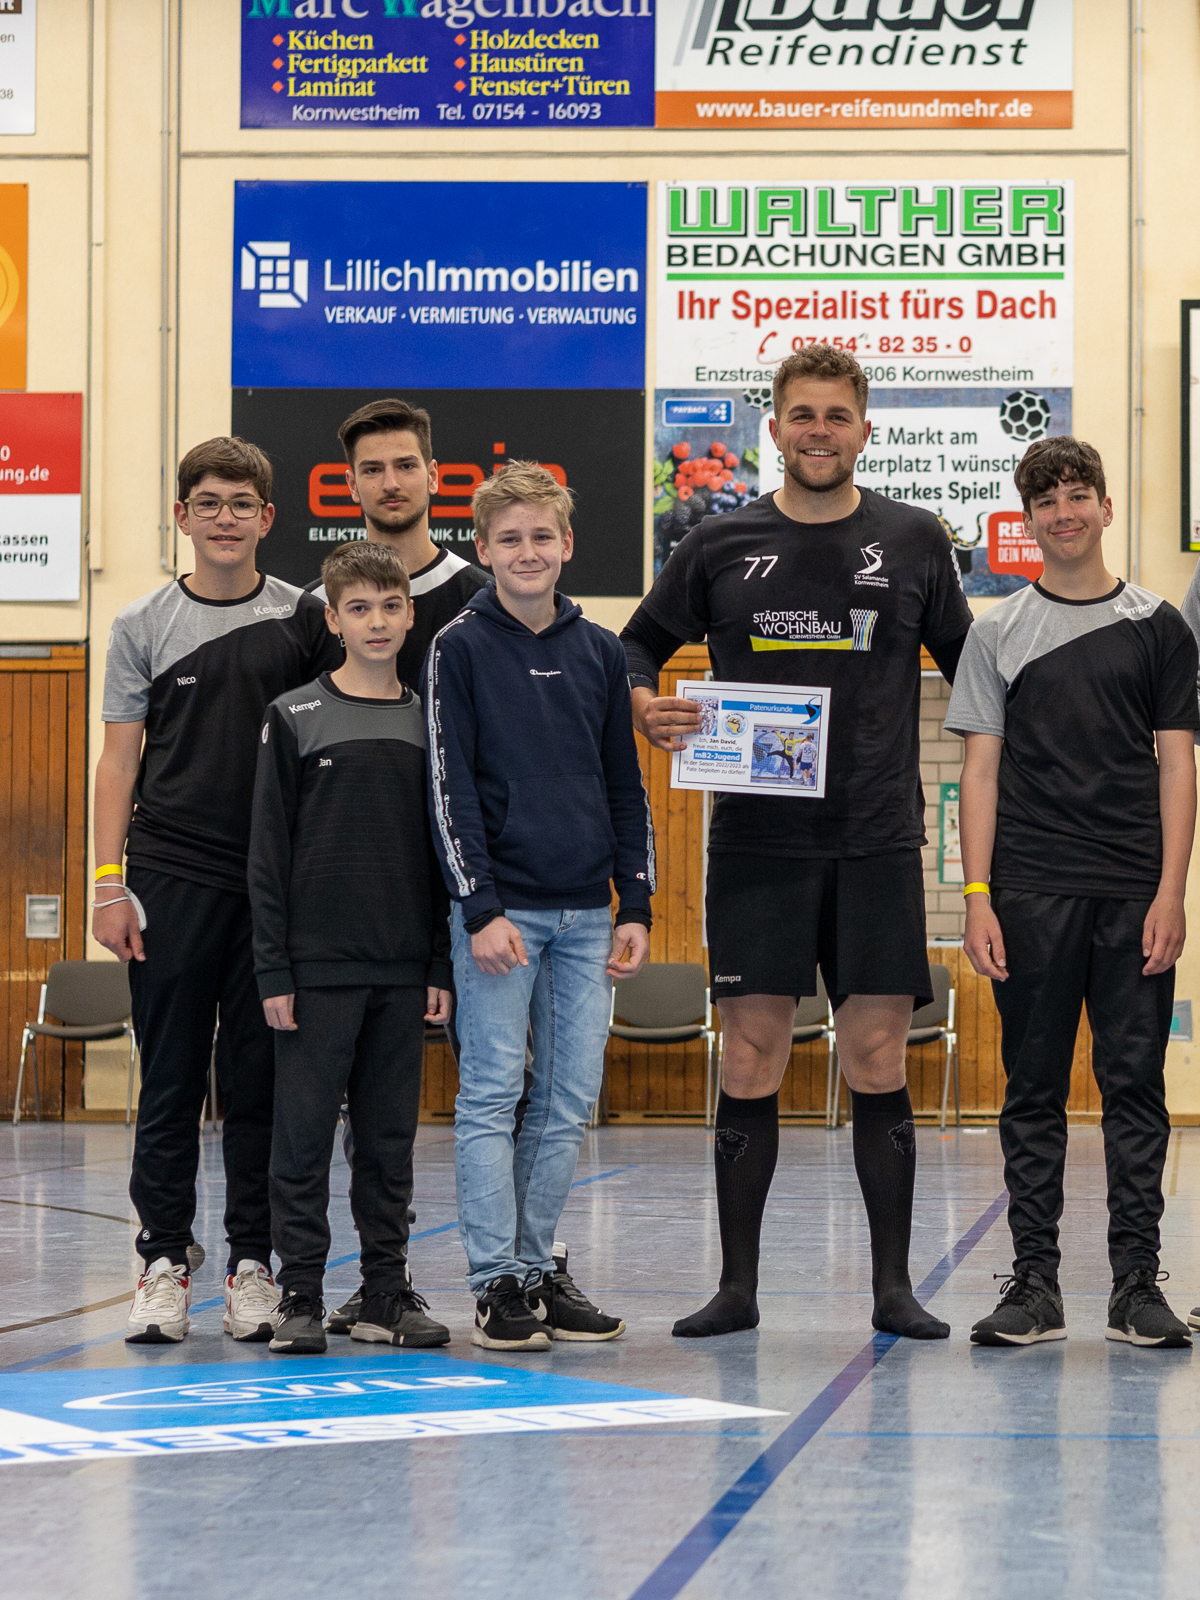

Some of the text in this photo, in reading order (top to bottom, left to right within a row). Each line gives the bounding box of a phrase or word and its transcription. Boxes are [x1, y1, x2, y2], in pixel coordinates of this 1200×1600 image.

[287, 30, 373, 50] Küchen
[469, 29, 599, 50] Holzdecken
[706, 35, 1028, 66] Reifendienst
[287, 53, 428, 78] Fertigparkett
[469, 53, 584, 73] Haustüren
[287, 77, 375, 97] Laminat
[469, 76, 630, 96] Fenster+Türen
[292, 103, 602, 121] Kornwestheim Tel. 07154 16093
[696, 98, 1033, 118] www.bauer-reifenundmehr.de
[667, 187, 1066, 237] WALTHER
[667, 243, 1066, 268] BEDACHUNGEN GMBH
[324, 259, 639, 292] LillichImmobilien
[325, 306, 637, 325] VERKAUF VERMIETUNG VERWALTUNG
[677, 288, 1057, 327] Ihr Spezialist fürs Dach
[879, 336, 905, 352] 82
[912, 336, 938, 352] 35
[959, 336, 972, 352] 0
[695, 366, 778, 382] Enzstras
[902, 366, 1034, 382] Kornwestheim
[887, 427, 943, 446] Markt
[949, 432, 978, 446] am
[939, 454, 946, 472] 1
[952, 454, 1020, 472] wünsch
[948, 481, 1001, 504] Spiel!
[0, 534, 48, 546] assen
[998, 547, 1043, 563] DEIN MAR
[743, 555, 779, 580] 77
[253, 602, 292, 617] Kempa
[753, 610, 819, 624] STÄDTISCHE
[759, 621, 842, 636] WOHNBAU
[177, 674, 197, 686] Nico
[288, 698, 322, 714] Kempa
[750, 703, 793, 713] Patenurkunde
[318, 757, 332, 767] Jan
[695, 752, 740, 761] mB2-Jugend
[715, 973, 741, 985] Kempa
[177, 1375, 508, 1401] SWLB
